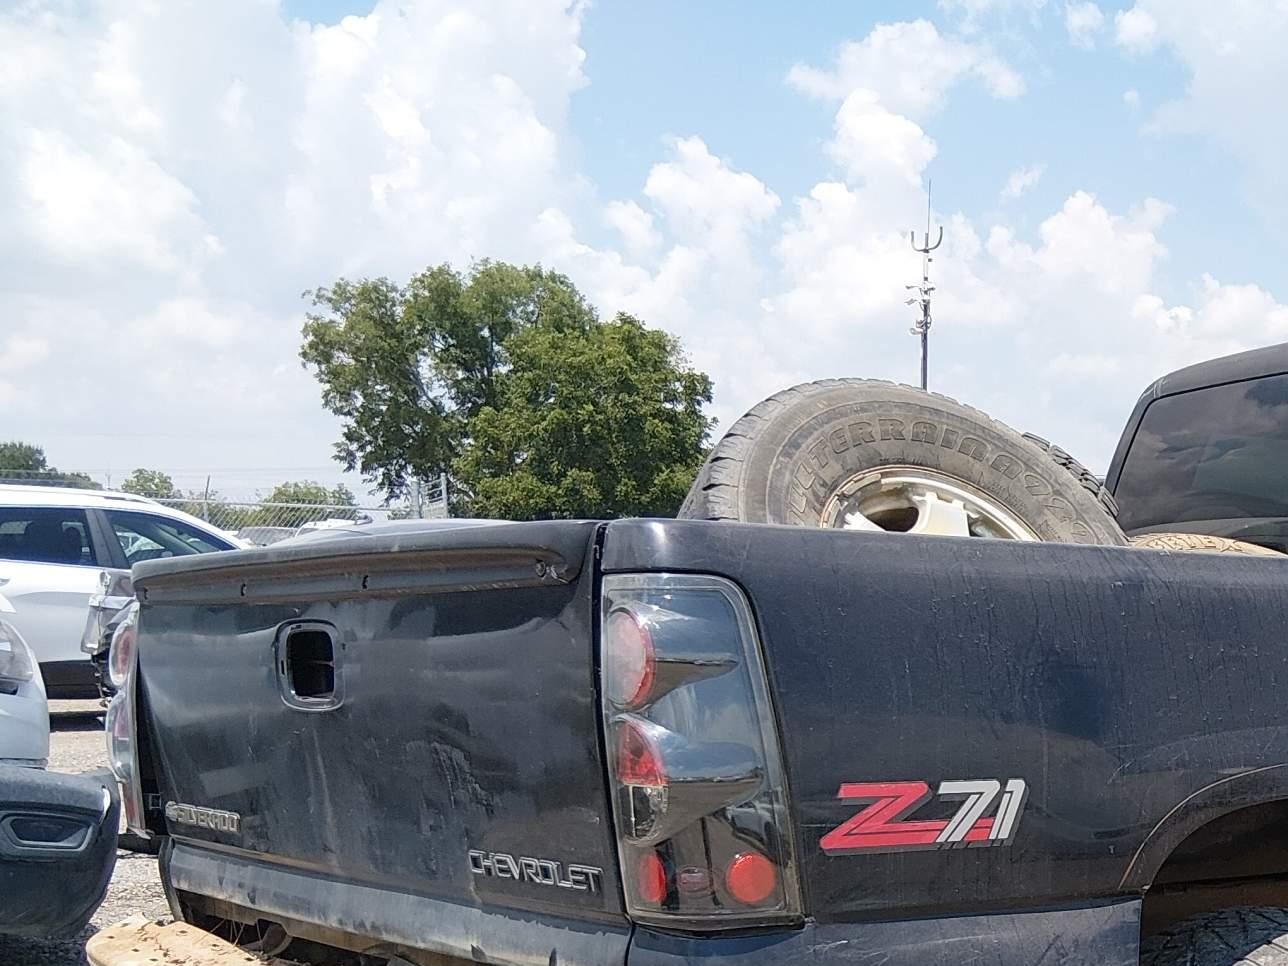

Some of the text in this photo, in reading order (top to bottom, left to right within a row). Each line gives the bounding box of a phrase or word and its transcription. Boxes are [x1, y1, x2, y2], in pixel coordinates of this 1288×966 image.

[175, 804, 241, 832] SILVERADO
[819, 778, 1029, 857] Z71
[468, 849, 604, 893] CHEVROLET
